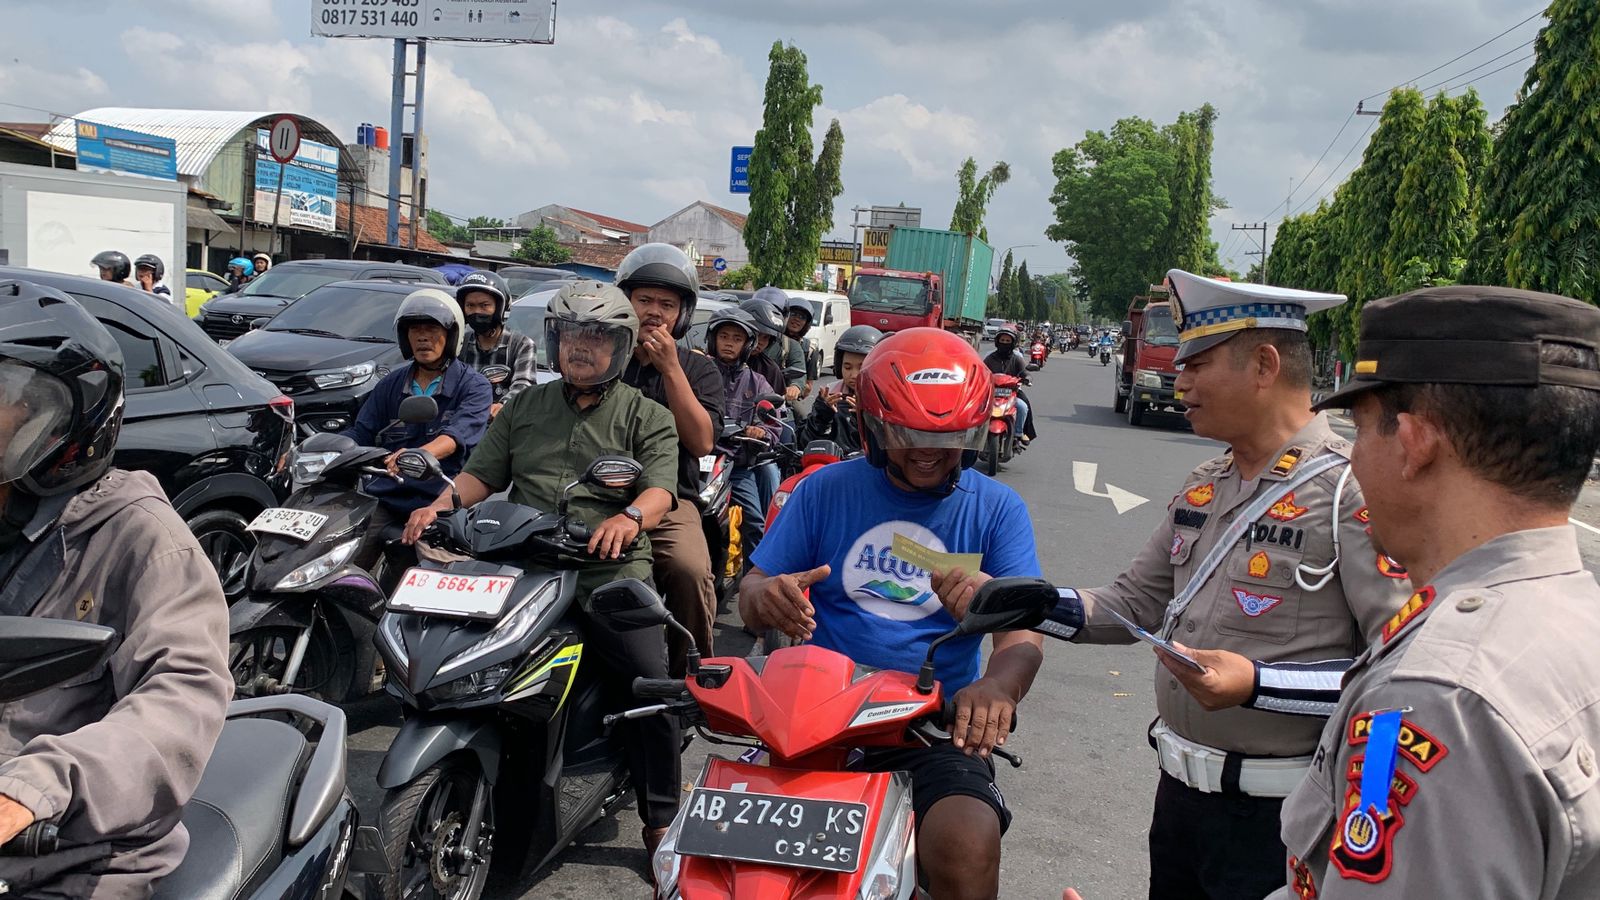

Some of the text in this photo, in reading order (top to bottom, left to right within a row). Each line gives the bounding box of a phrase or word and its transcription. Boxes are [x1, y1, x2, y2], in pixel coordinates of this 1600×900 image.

[321, 9, 418, 27] 0817 531 440
[274, 510, 303, 521] 6937
[1242, 522, 1304, 549] OLRI
[854, 543, 933, 582] AQU
[405, 573, 509, 593] AB 6684 XY
[867, 706, 914, 718] Combi Brake
[690, 793, 863, 834] AB 2749 KS
